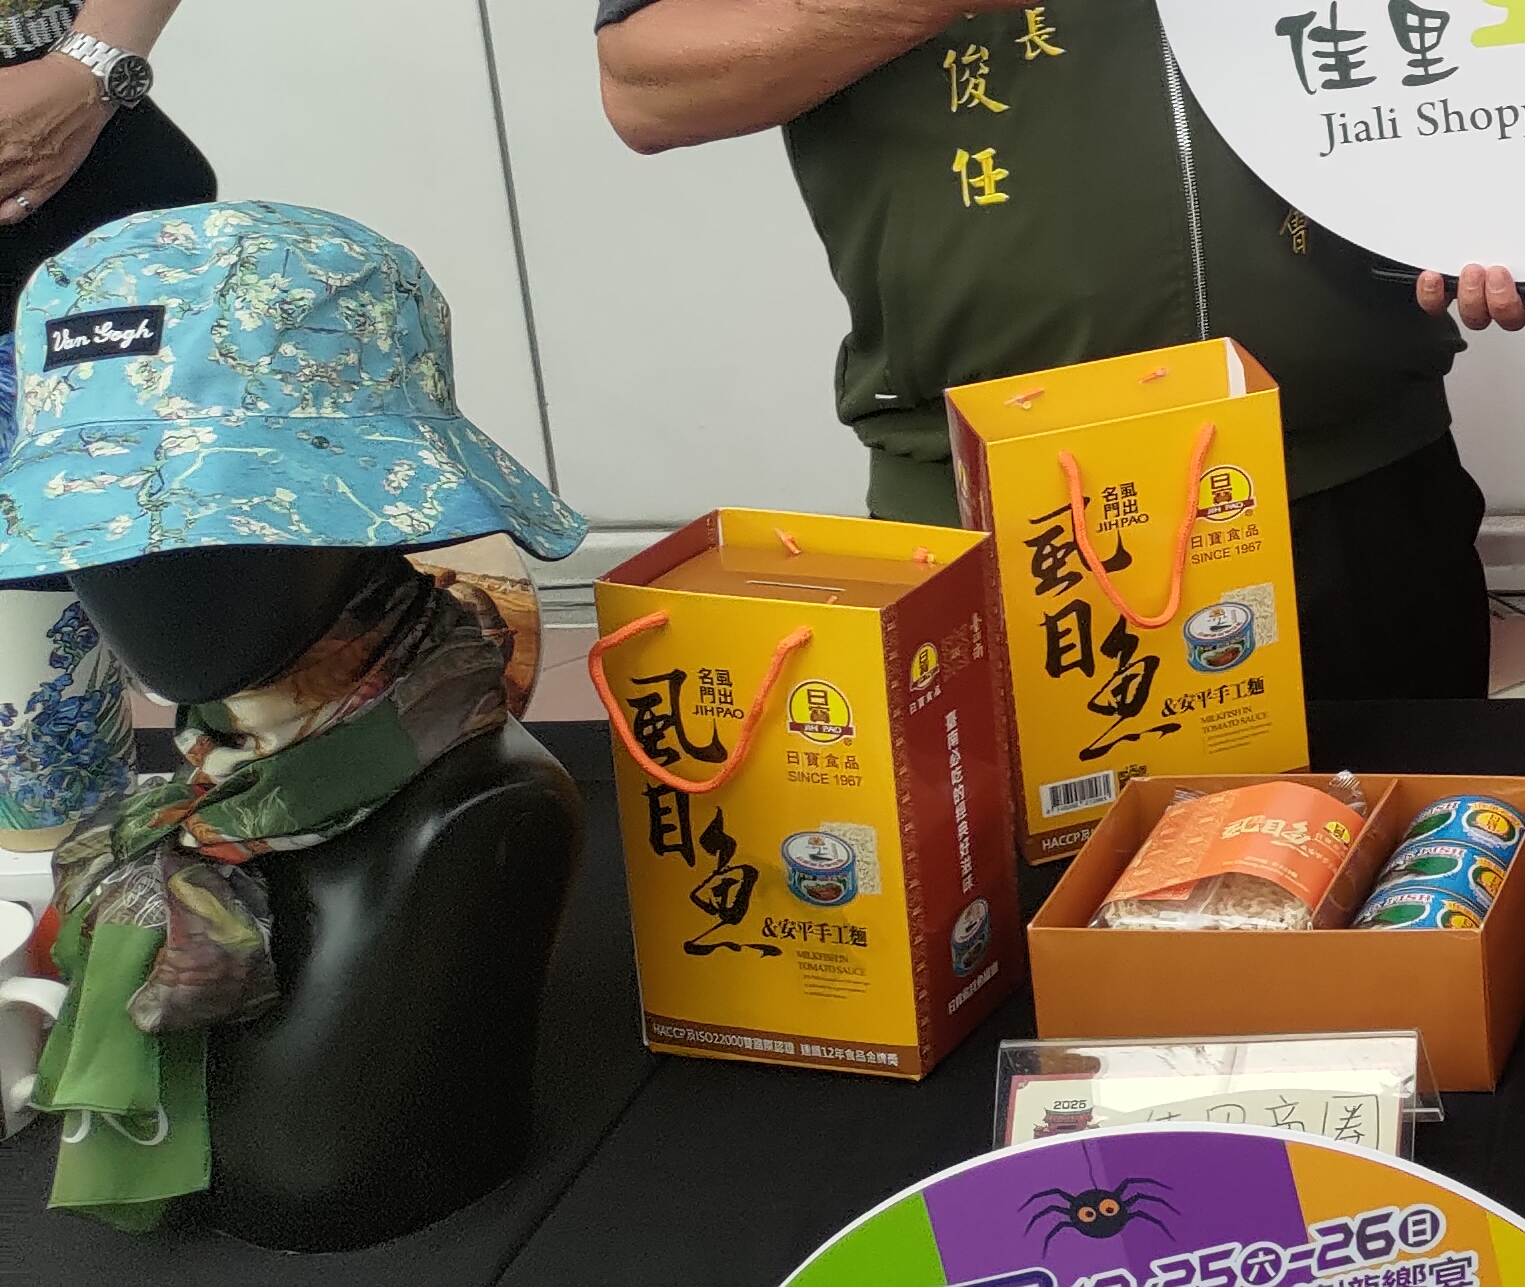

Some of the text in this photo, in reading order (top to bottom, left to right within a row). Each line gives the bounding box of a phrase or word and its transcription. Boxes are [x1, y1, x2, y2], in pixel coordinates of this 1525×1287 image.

[1320, 106, 1399, 158] Jiali
[53, 319, 154, 352] Van Gogh
[1191, 547, 1232, 565] SINCE
[788, 771, 830, 785] SINCE
[1053, 1099, 1088, 1110] 2025
